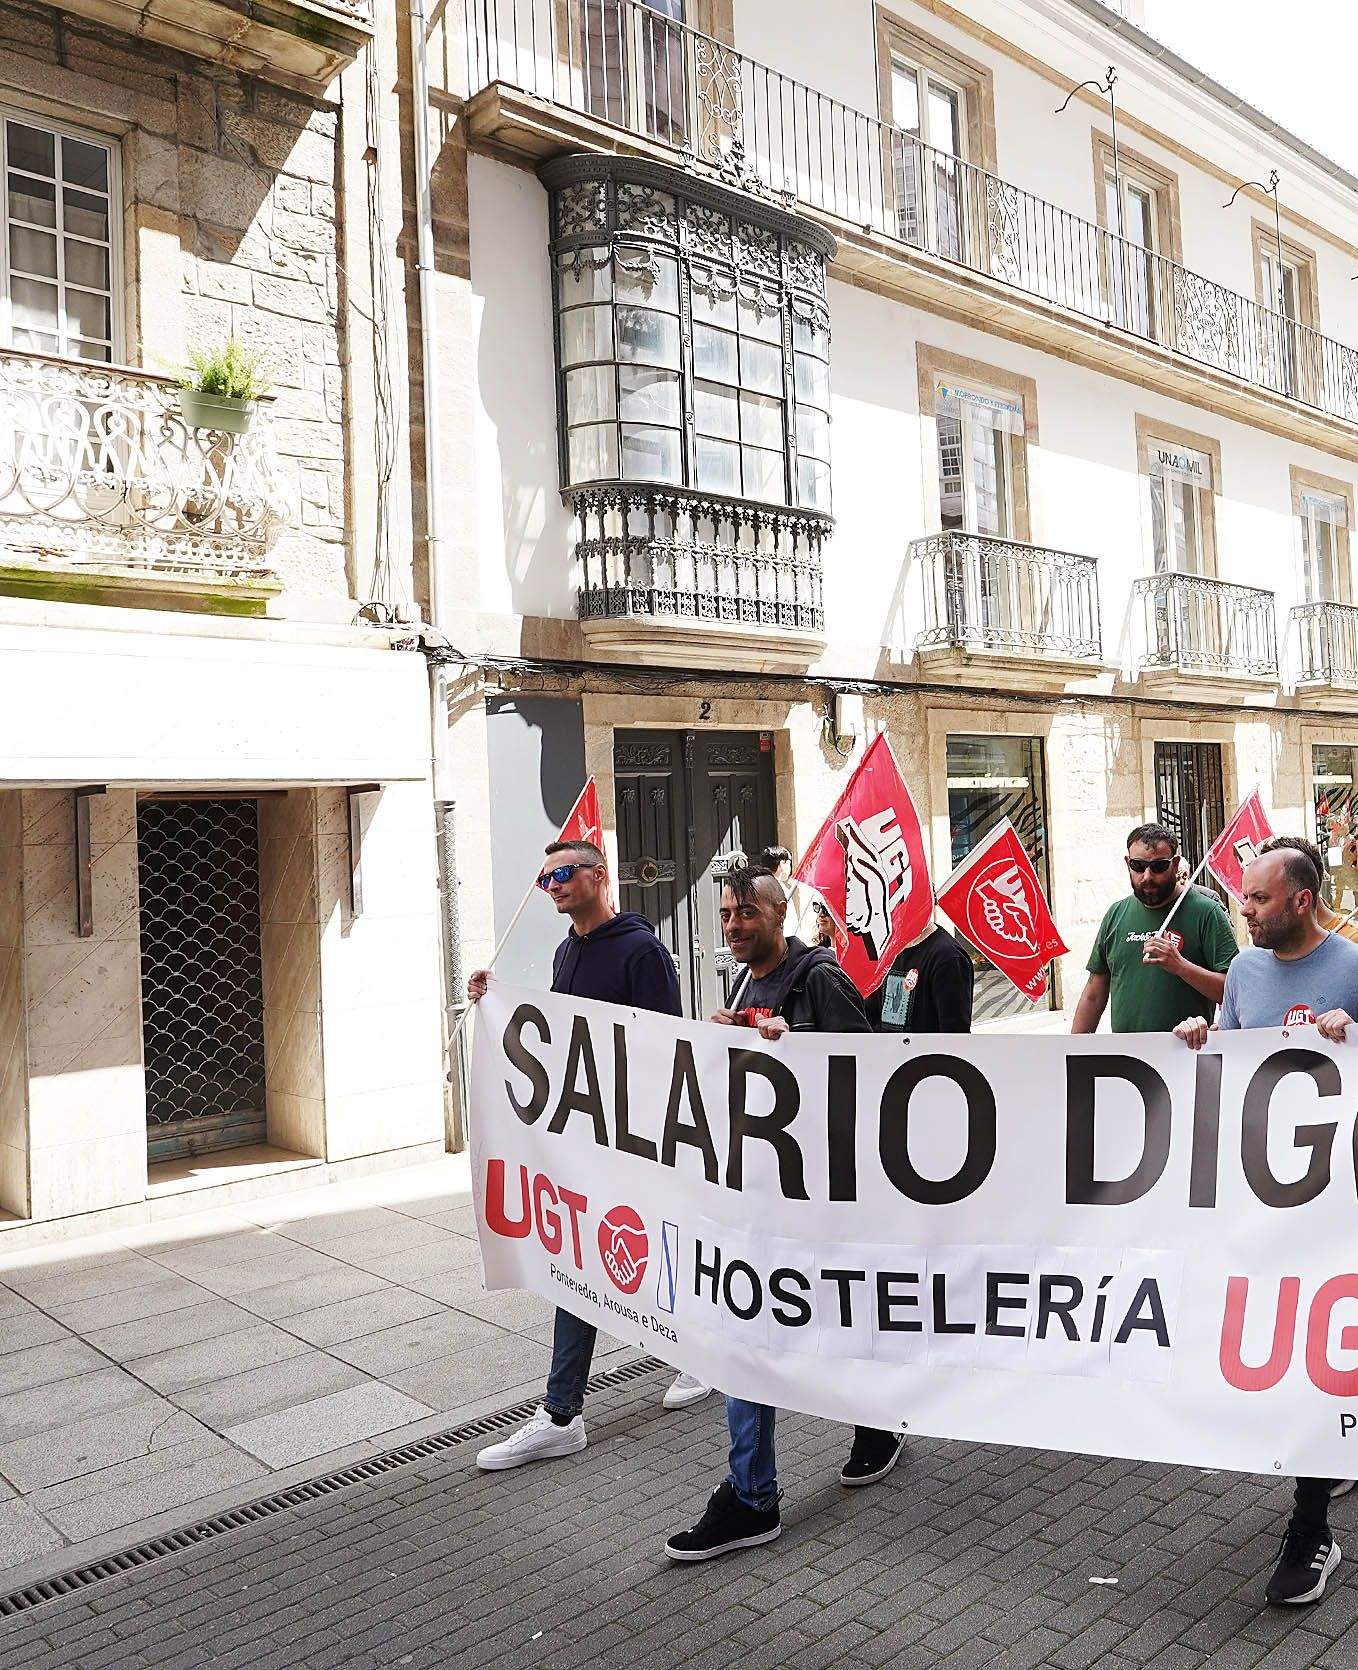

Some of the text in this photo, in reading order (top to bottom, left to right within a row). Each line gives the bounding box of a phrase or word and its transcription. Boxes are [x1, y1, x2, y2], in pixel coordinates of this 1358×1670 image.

[698, 702, 711, 720] 2
[860, 806, 913, 912] UGT
[1287, 1009, 1311, 1025] UGT
[503, 1003, 997, 1206] SALARIO
[485, 1159, 588, 1270] UGT
[550, 1262, 678, 1344] Pontevedra, Arousa e Deza
